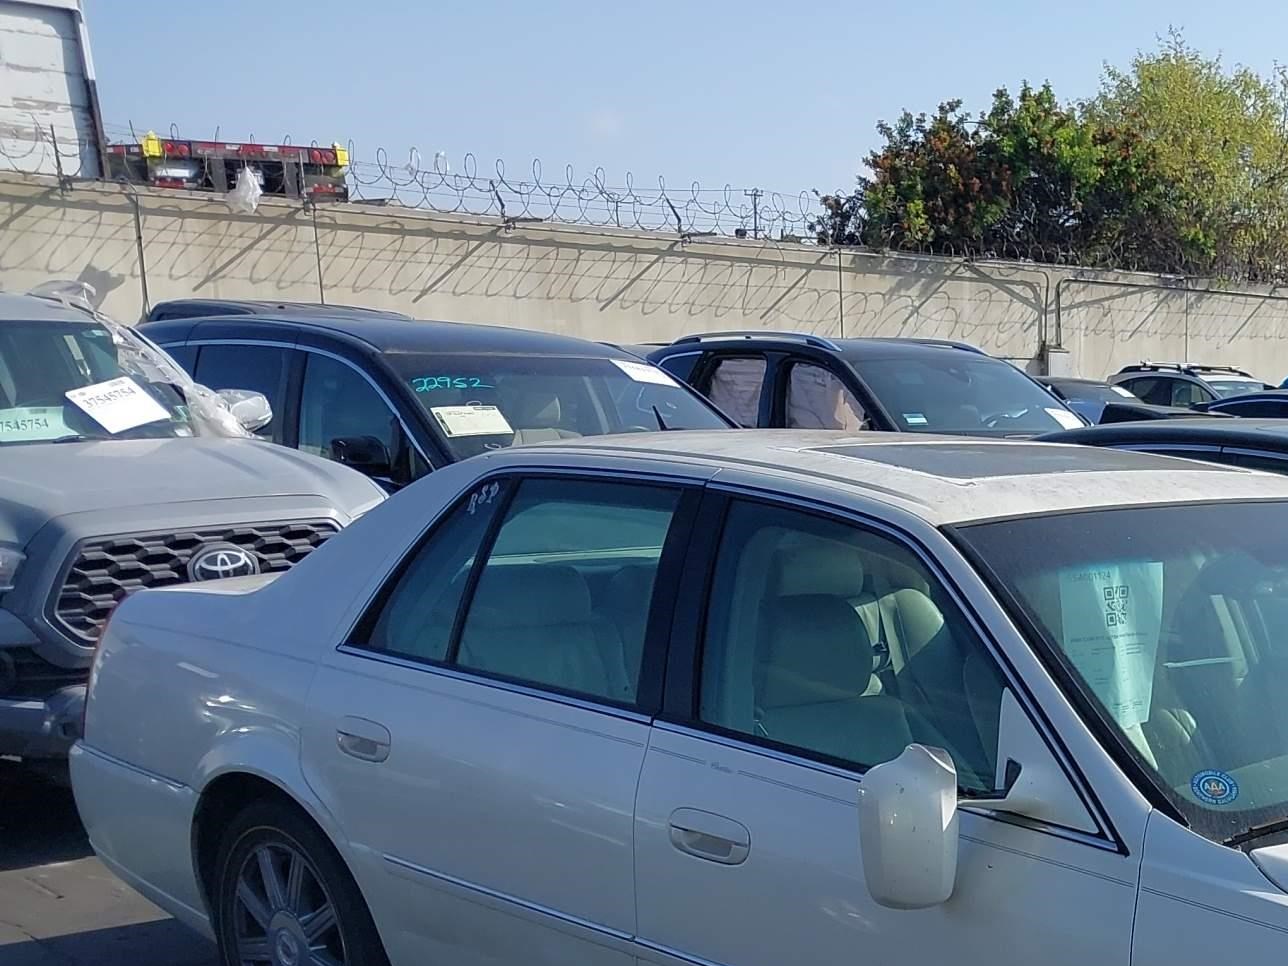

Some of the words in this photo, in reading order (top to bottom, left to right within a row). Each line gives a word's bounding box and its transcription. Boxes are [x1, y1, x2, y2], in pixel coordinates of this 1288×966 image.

[412, 376, 495, 392] 22952
[82, 386, 137, 409] 37545754
[1204, 781, 1226, 791] AAA
